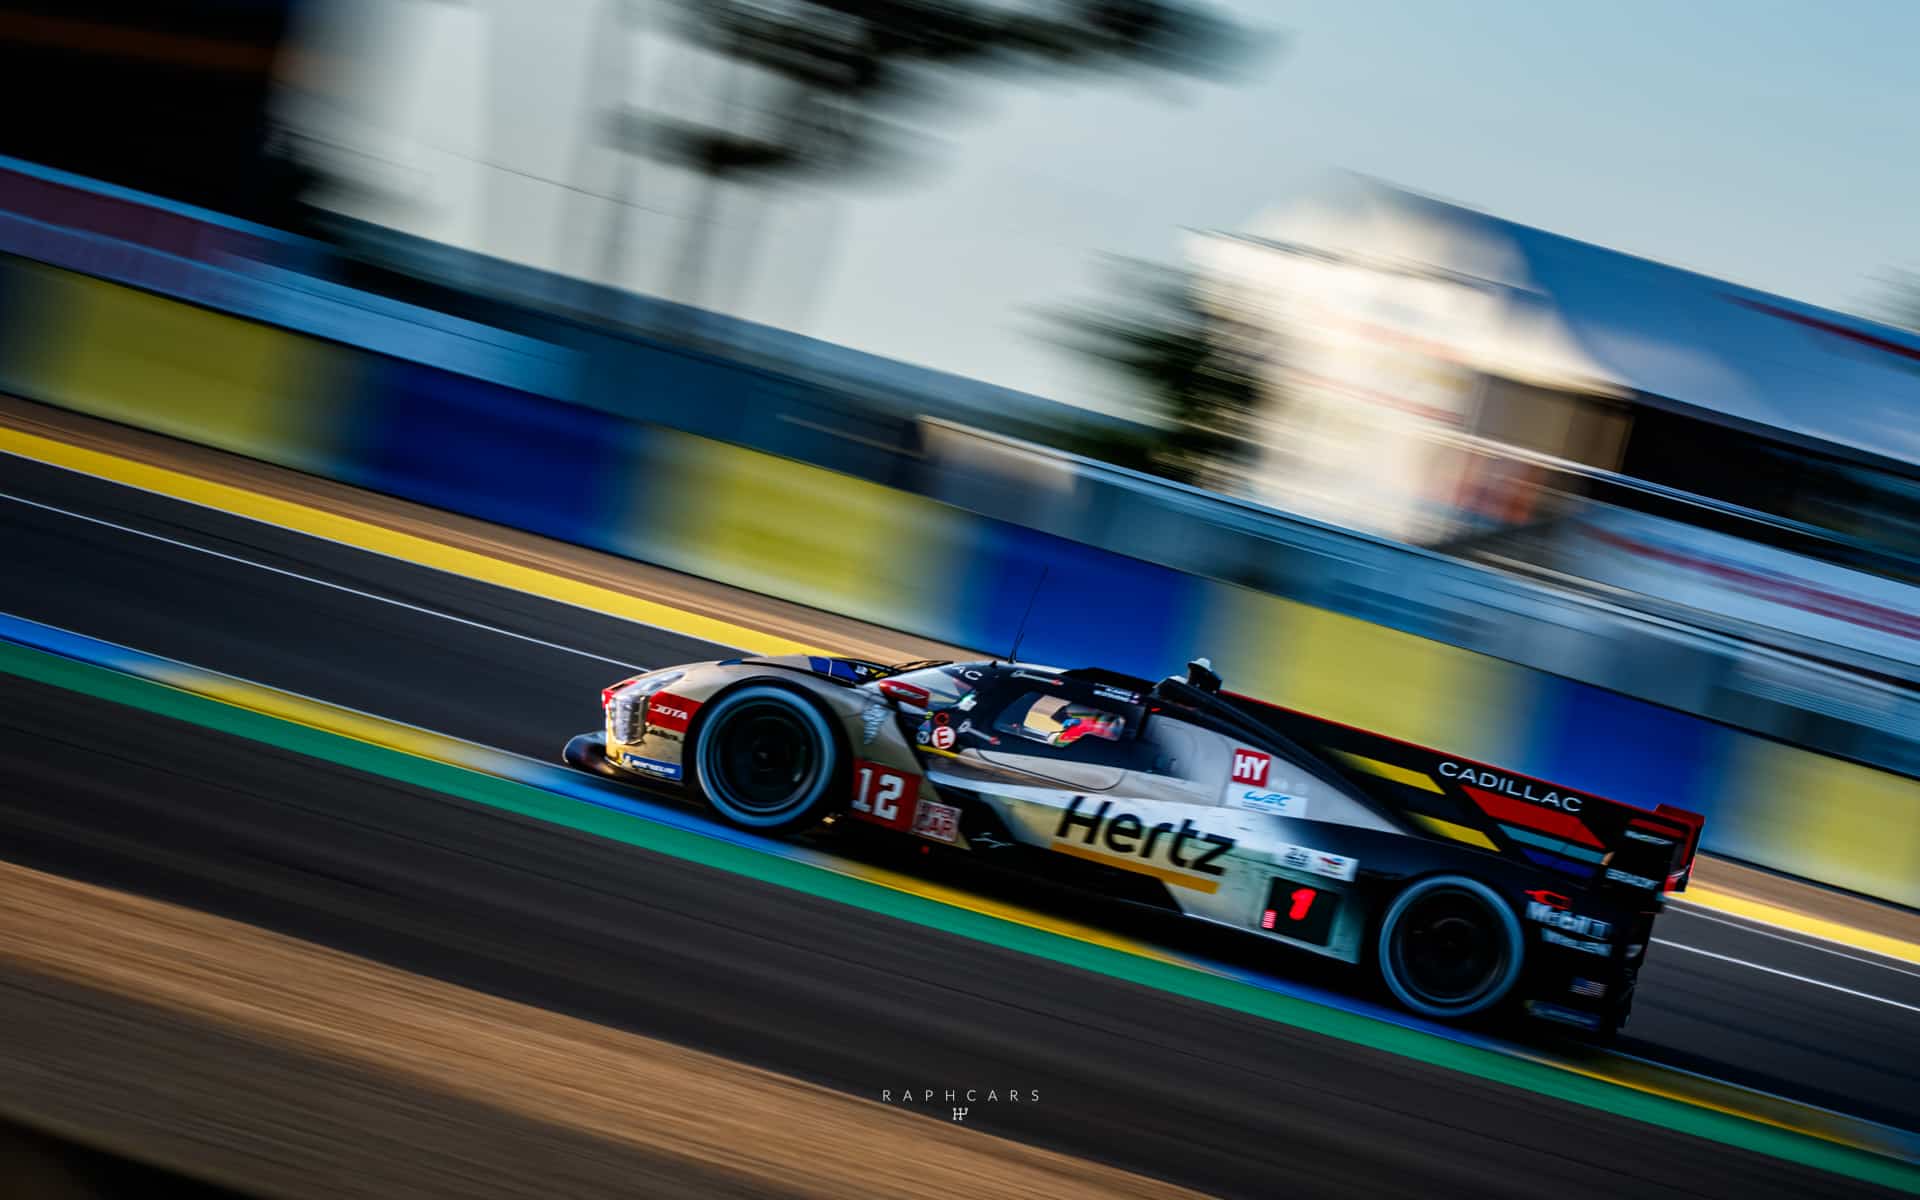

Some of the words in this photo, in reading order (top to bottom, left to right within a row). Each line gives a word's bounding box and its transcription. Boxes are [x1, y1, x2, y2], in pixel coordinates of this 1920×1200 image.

[648, 703, 688, 720] JOTA
[1233, 754, 1269, 781] HY
[852, 768, 904, 821] 12
[1243, 790, 1292, 807] WEC
[1438, 761, 1582, 812] CADILLAC
[1056, 795, 1236, 876] Hertz
[1289, 888, 1318, 921] 1
